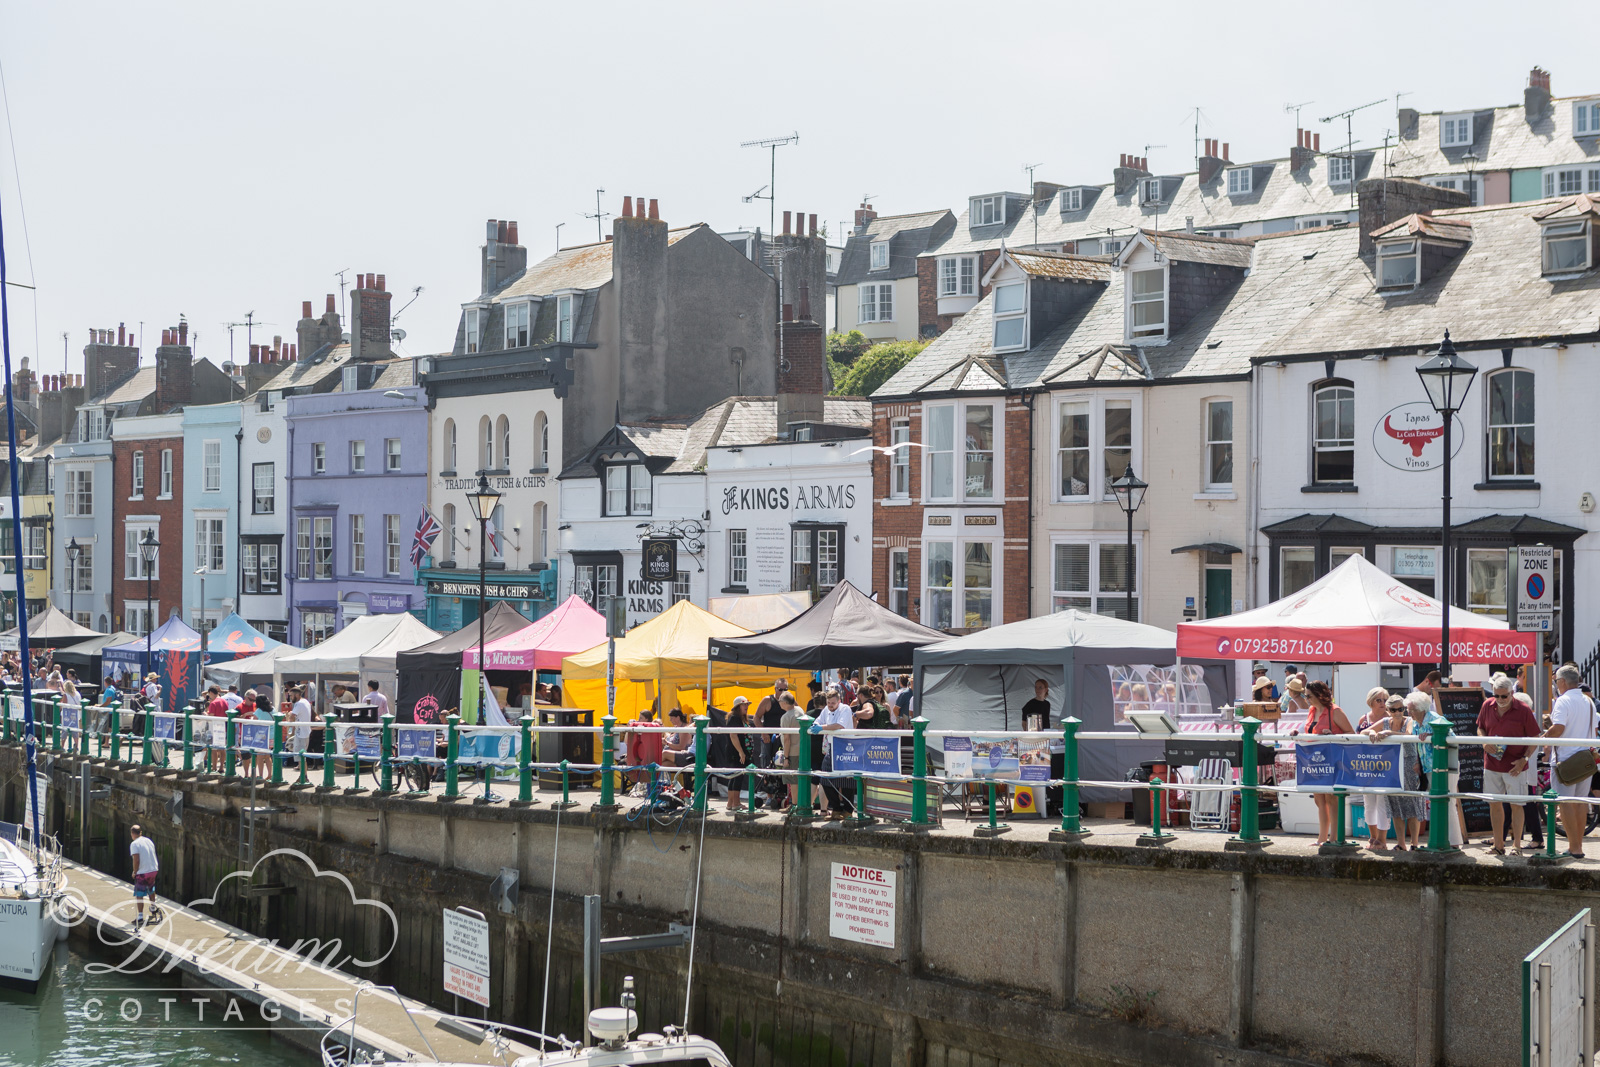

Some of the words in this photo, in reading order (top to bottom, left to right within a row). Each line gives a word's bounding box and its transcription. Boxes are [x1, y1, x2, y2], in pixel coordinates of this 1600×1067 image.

[1404, 412, 1430, 425] Tapas
[1406, 457, 1430, 468] Vinos
[496, 478, 514, 488] FISH
[516, 478, 521, 488] &
[522, 476, 546, 488] CHIPS
[740, 487, 790, 510] KINGS
[795, 484, 856, 509] ARMS
[1524, 560, 1548, 570] ZONE
[500, 586, 506, 596] &
[506, 586, 528, 598] CHIPS
[628, 580, 663, 596] KINGS
[628, 598, 663, 613] ARMS
[1539, 602, 1552, 610] time
[1234, 638, 1333, 656] 07925871620
[1390, 642, 1412, 657] SEA
[1416, 642, 1432, 657] TO
[1436, 642, 1473, 658] SORE
[1477, 643, 1529, 659] SEAFOOD
[492, 652, 524, 664] Winters
[866, 750, 894, 760] SEAFOOD
[1350, 760, 1392, 772] SEAFOOD
[842, 865, 886, 882] NOTICE.
[847, 884, 862, 892] BERTH
[845, 902, 858, 910] TOWN
[858, 906, 874, 914] BRIDGE
[858, 896, 874, 904] CRAFT
[875, 900, 894, 908] WAITING
[845, 914, 860, 922] OTHER
[860, 916, 883, 926] BERTHING
